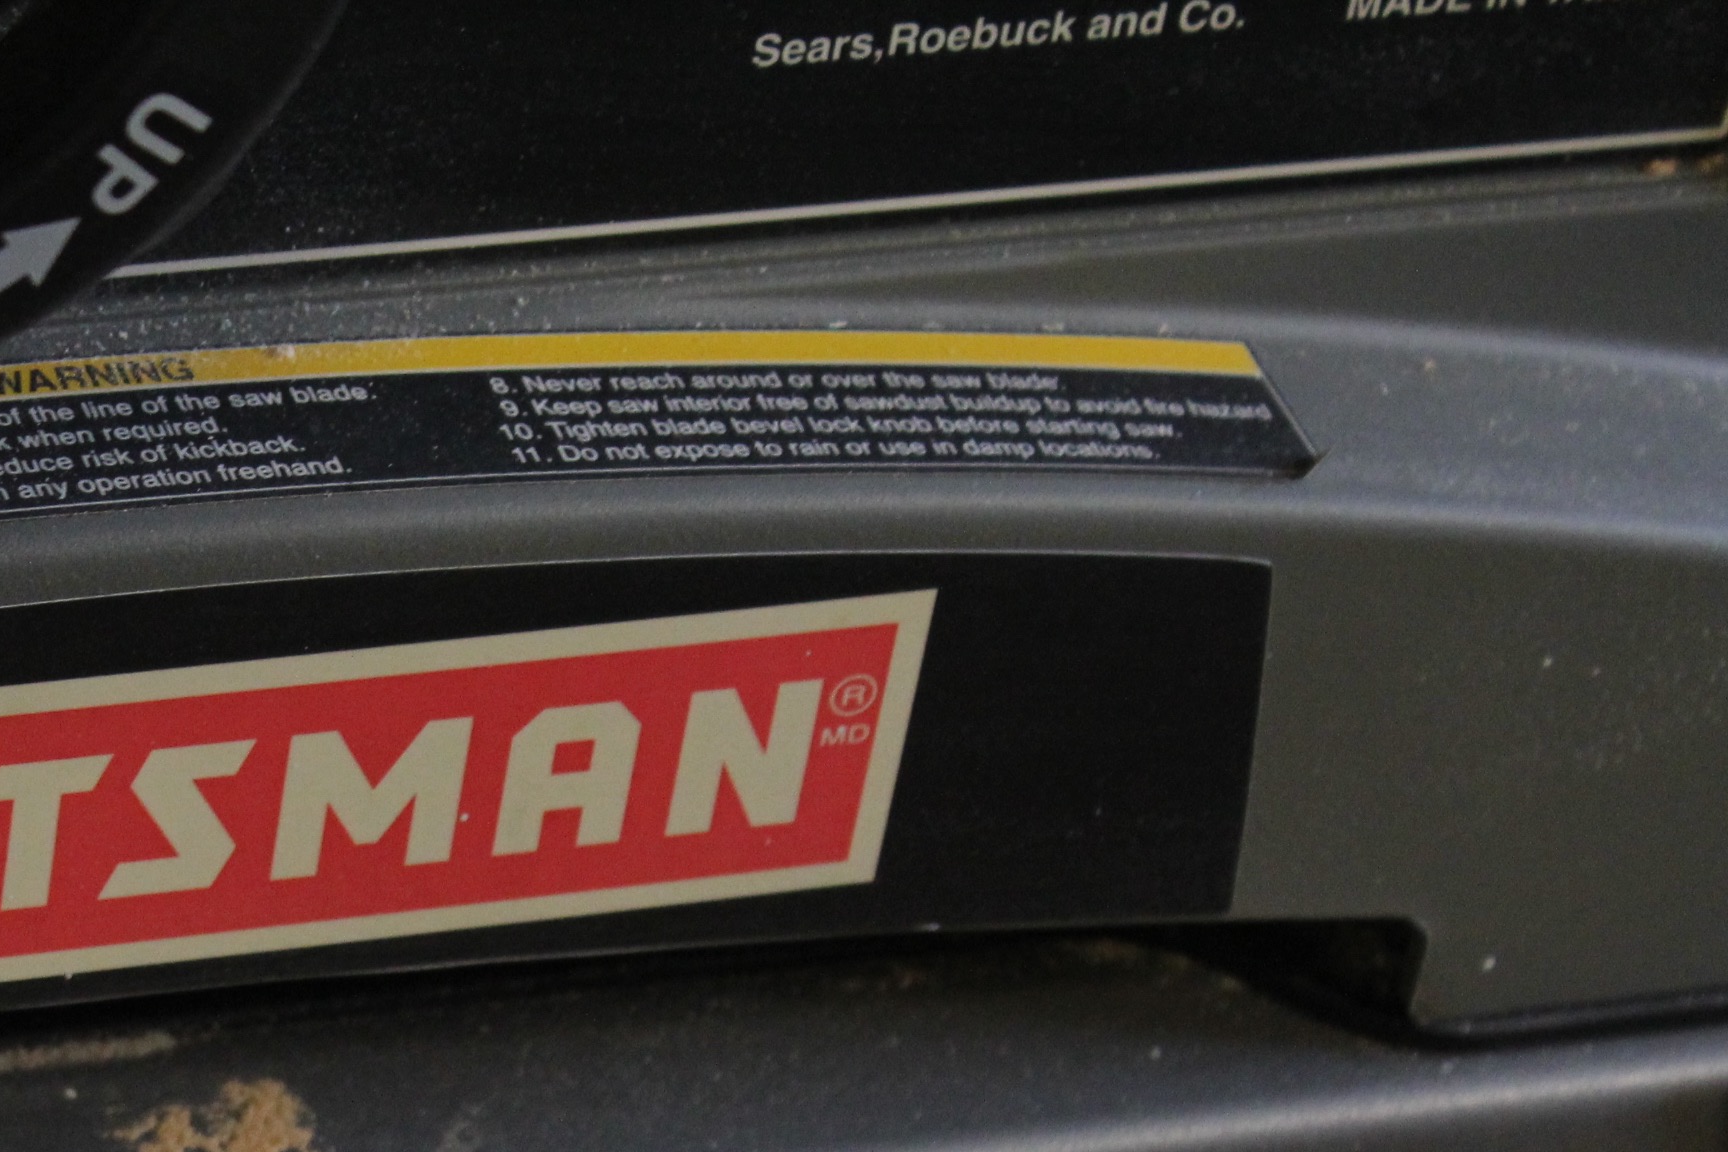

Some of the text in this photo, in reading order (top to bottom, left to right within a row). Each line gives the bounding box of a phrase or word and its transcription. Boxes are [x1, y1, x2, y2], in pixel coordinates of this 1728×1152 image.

[1086, 2, 1168, 41] and
[1178, 0, 1245, 33] Co.
[90, 91, 213, 215] UP
[489, 377, 518, 394] 8.
[522, 376, 602, 393] Never
[609, 372, 685, 391] reach
[691, 371, 782, 390] around
[788, 373, 813, 388] or
[821, 373, 876, 388] over
[881, 371, 925, 388] the
[930, 373, 982, 389] saw
[28, 404, 75, 425] the
[80, 401, 133, 420] line
[140, 396, 168, 415] of
[175, 393, 221, 412] the
[228, 389, 283, 408] saw
[289, 383, 377, 404] blade.
[499, 400, 528, 418] 9.
[530, 398, 603, 417] Keep
[607, 397, 659, 413] saw
[664, 394, 751, 412] interior
[756, 393, 809, 411] free
[813, 393, 839, 410] of
[844, 394, 949, 411] sawdust
[949, 393, 1042, 415] buildup
[1044, 396, 1071, 413] to
[17, 426, 94, 450] when
[101, 416, 228, 446] required.
[498, 423, 542, 441] 10.
[544, 420, 648, 442] Tighten
[651, 417, 727, 435] blade
[729, 416, 804, 434] bevel
[807, 416, 864, 433] lock
[866, 415, 933, 433] knob
[935, 415, 1020, 434] before
[1026, 419, 1121, 440] starting
[81, 447, 135, 469] risk
[140, 441, 168, 463] of
[175, 435, 306, 461] kickback.
[511, 446, 553, 463] 11.
[556, 444, 599, 462] Do
[604, 442, 650, 460] not
[653, 442, 751, 462] expose
[753, 441, 783, 457] to
[789, 440, 840, 456] rain
[845, 441, 870, 455] or
[878, 441, 926, 455] use
[932, 440, 958, 455] in
[962, 439, 1035, 460] damp
[17, 481, 69, 500] any
[77, 467, 212, 497] operation
[218, 456, 352, 482] freehand.
[820, 723, 870, 746] MD
